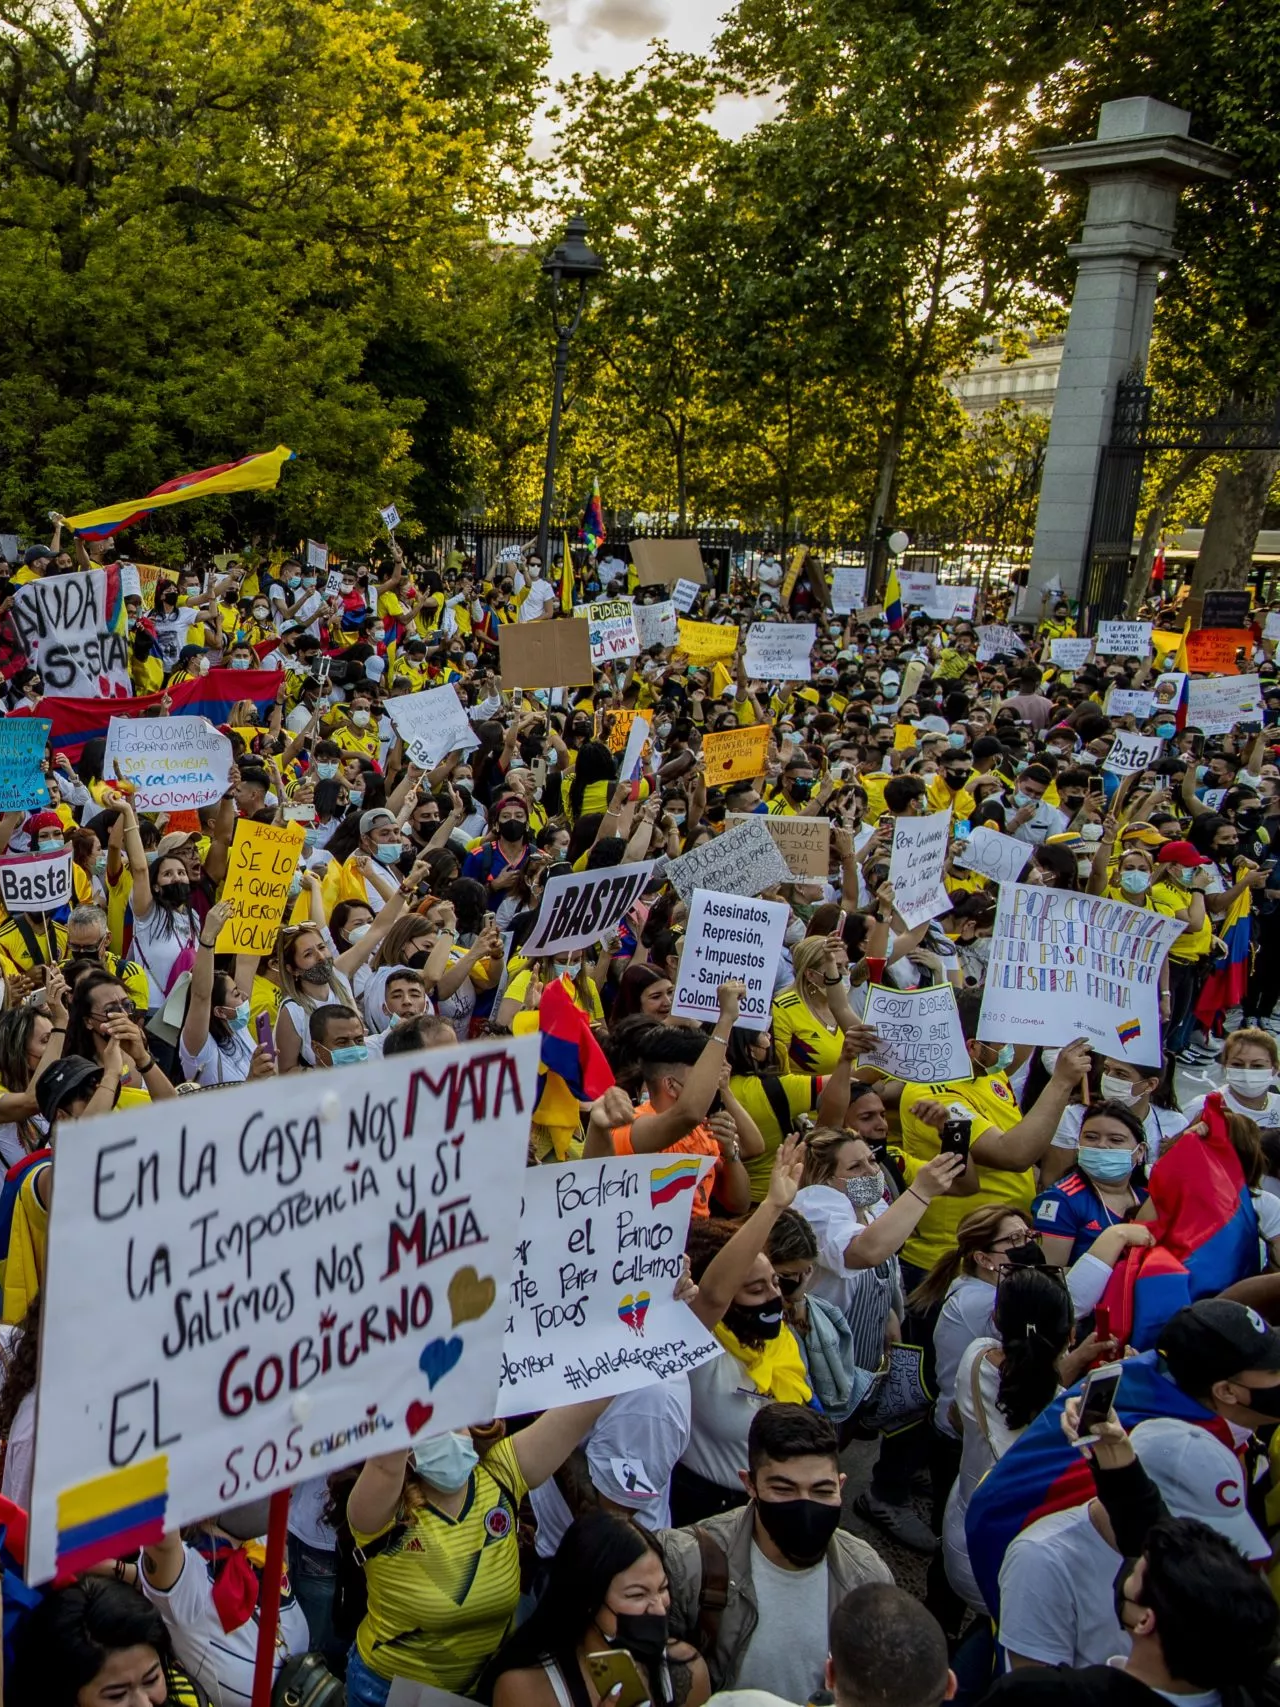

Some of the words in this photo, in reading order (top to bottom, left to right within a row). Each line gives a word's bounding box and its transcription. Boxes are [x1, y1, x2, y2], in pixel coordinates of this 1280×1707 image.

[751, 624, 766, 633] NO
[118, 726, 137, 739] EN
[144, 724, 207, 741] COLOMBIA
[110, 741, 121, 751] EL
[170, 741, 193, 751] MATA
[237, 841, 262, 871] SE
[272, 849, 292, 875] LO
[2, 857, 72, 900] Basta!
[234, 876, 242, 892] A
[249, 877, 289, 898] QUIEN
[703, 900, 771, 925] Asesinatos,
[1014, 888, 1058, 919] POR
[1064, 896, 1166, 939] COLOMBIA
[702, 922, 764, 947] Represión,
[999, 912, 1081, 945] SIEMPRE
[695, 947, 702, 958] +
[705, 946, 765, 968] Impuestos
[1040, 943, 1086, 966] PASO
[1127, 961, 1157, 984] POR
[748, 979, 762, 991] en
[991, 963, 1079, 993] NUESTRA
[1086, 972, 1133, 1010] PATRIA
[739, 996, 767, 1014] SOS.
[873, 996, 913, 1018] CON
[919, 992, 955, 1016] DOLOR
[876, 1021, 923, 1043] PERO
[1010, 1016, 1045, 1026] COLOMBIA
[883, 1042, 953, 1062] MIEDO
[403, 1049, 525, 1139] MATA
[379, 1195, 490, 1284] MATA
[567, 1218, 595, 1255] el
[108, 1378, 182, 1469] EL
[218, 1283, 434, 1419] GOBIERNO
[1215, 1479, 1241, 1508] C
